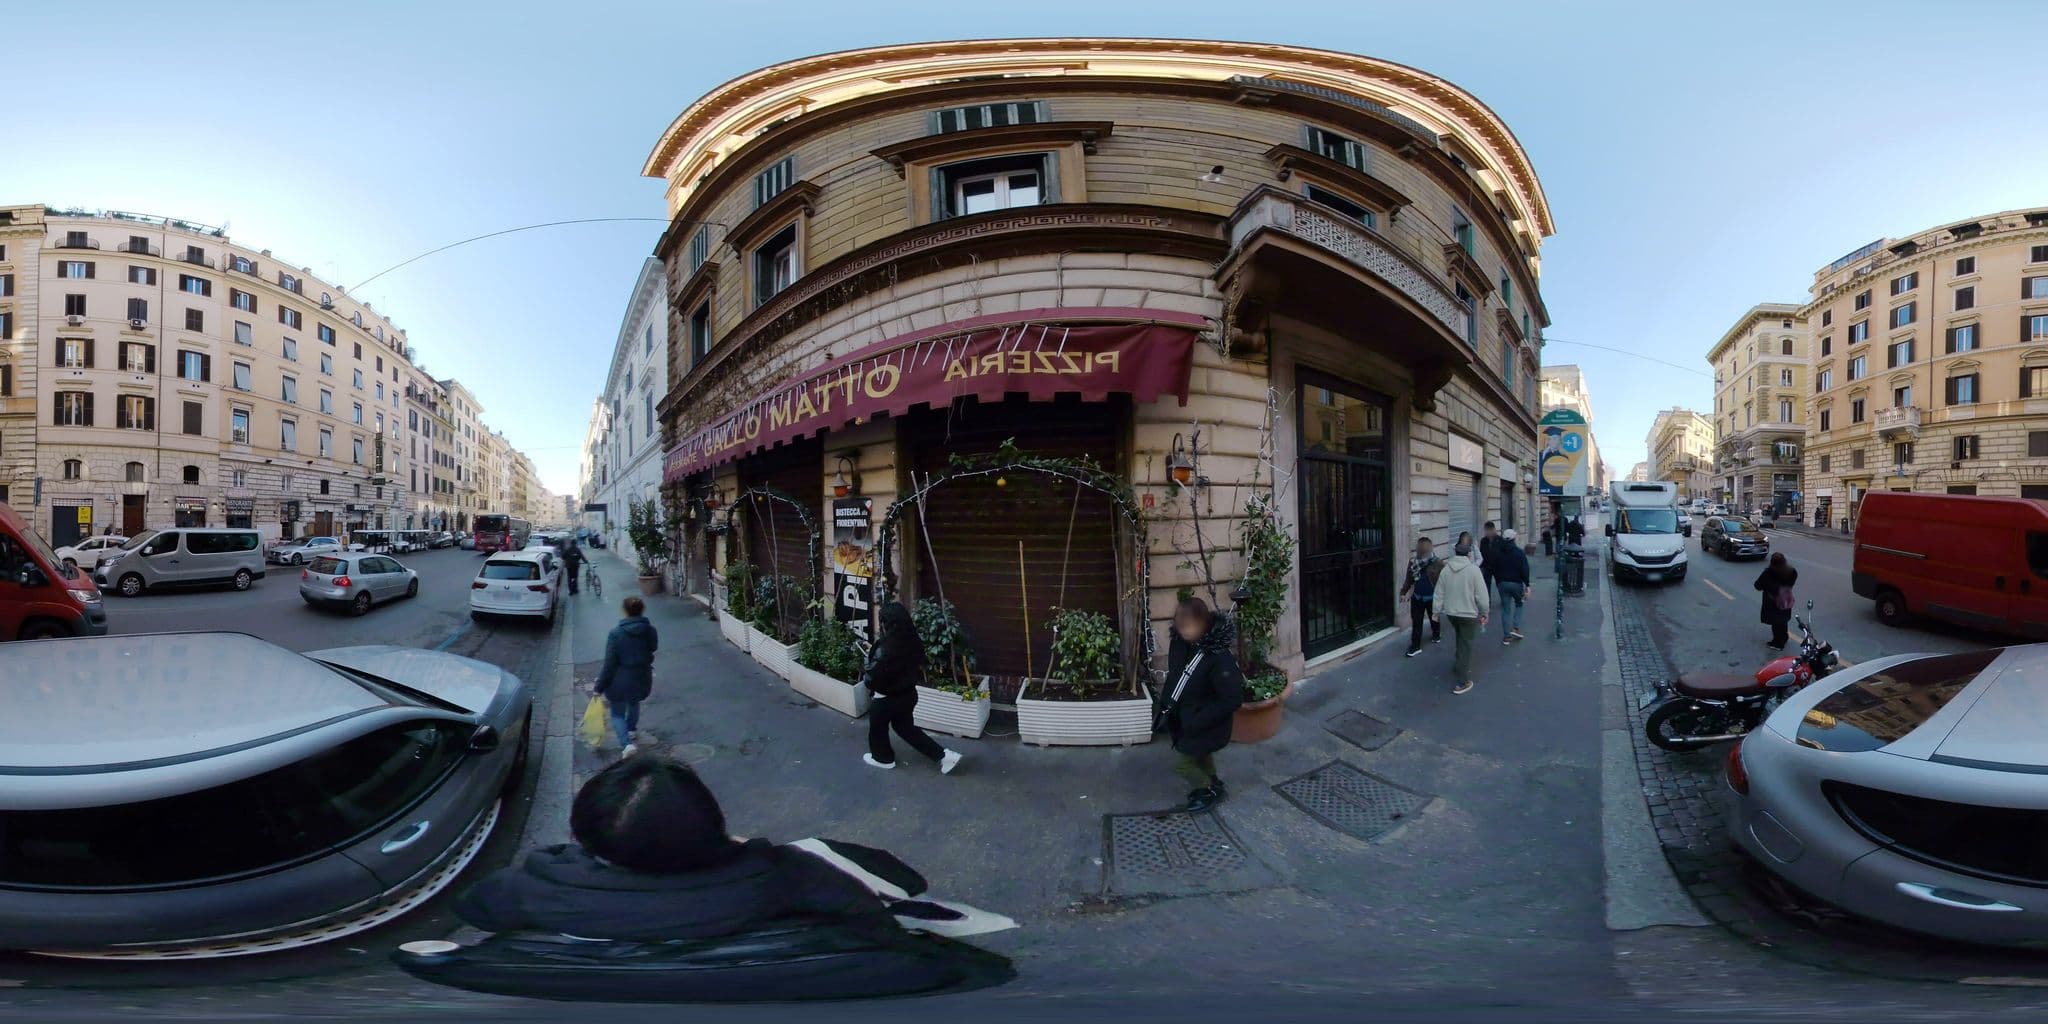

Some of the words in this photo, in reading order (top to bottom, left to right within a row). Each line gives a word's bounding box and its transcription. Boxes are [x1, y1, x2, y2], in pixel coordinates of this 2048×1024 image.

[704, 415, 760, 457] GALLO
[769, 364, 900, 431] MATTO
[836, 508, 860, 517] BISTECCA
[836, 519, 867, 528] FIORENTINA
